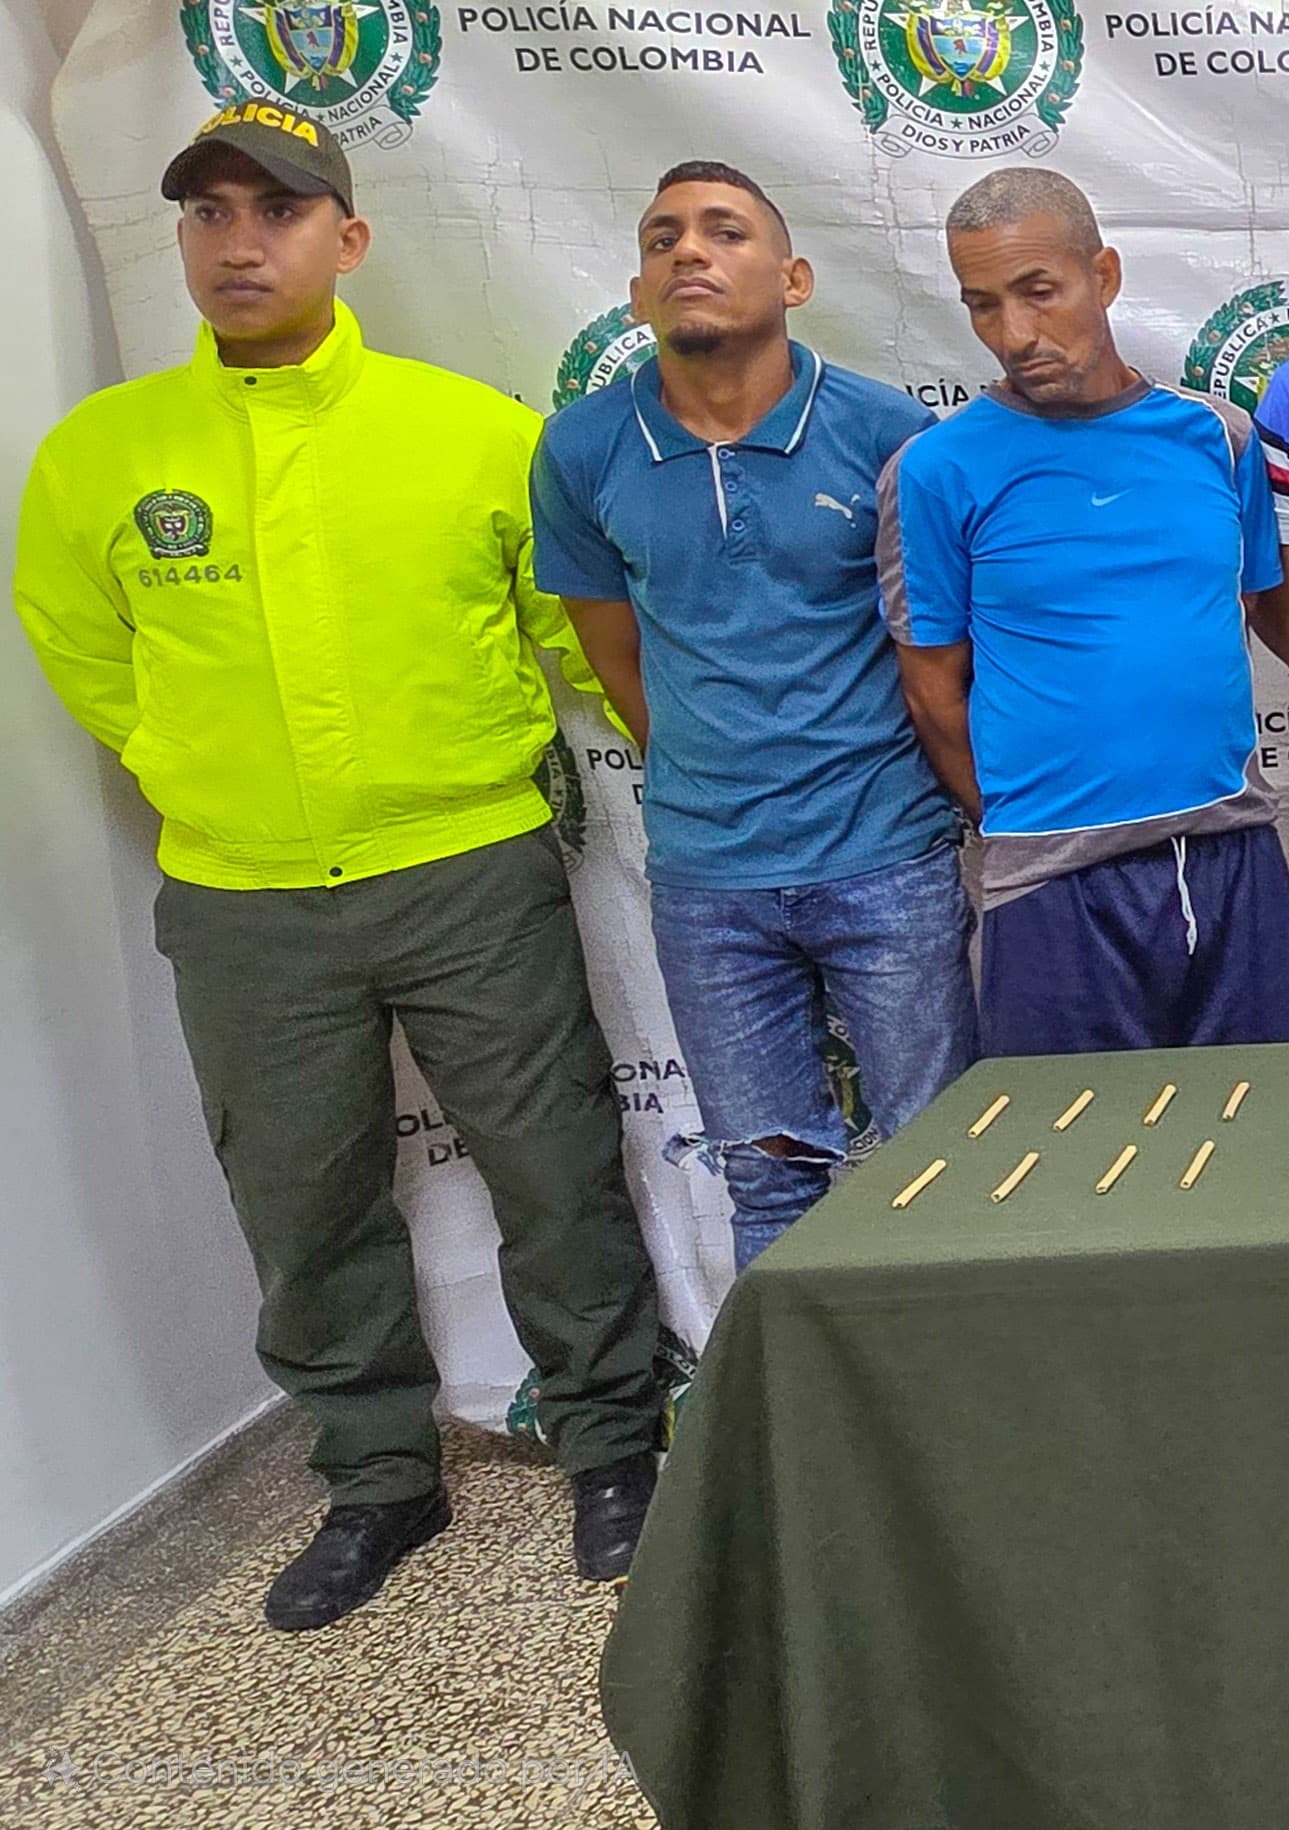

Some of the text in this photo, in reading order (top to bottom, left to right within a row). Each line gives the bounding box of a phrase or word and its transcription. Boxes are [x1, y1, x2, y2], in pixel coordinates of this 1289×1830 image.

[458, 1, 811, 37] POLICÍA NACIONAL
[1105, 5, 1240, 38] POLICÍA
[515, 47, 764, 73] DE COLOMBIA
[1155, 52, 1198, 76] DE
[328, 63, 401, 122] NACIONAL
[967, 73, 1049, 130] NACIONAL
[902, 124, 1031, 153] DIOS Y PATRIA
[592, 330, 649, 388] UBLICA
[1213, 317, 1268, 400] EPUBLICA
[139, 564, 243, 588] 614464
